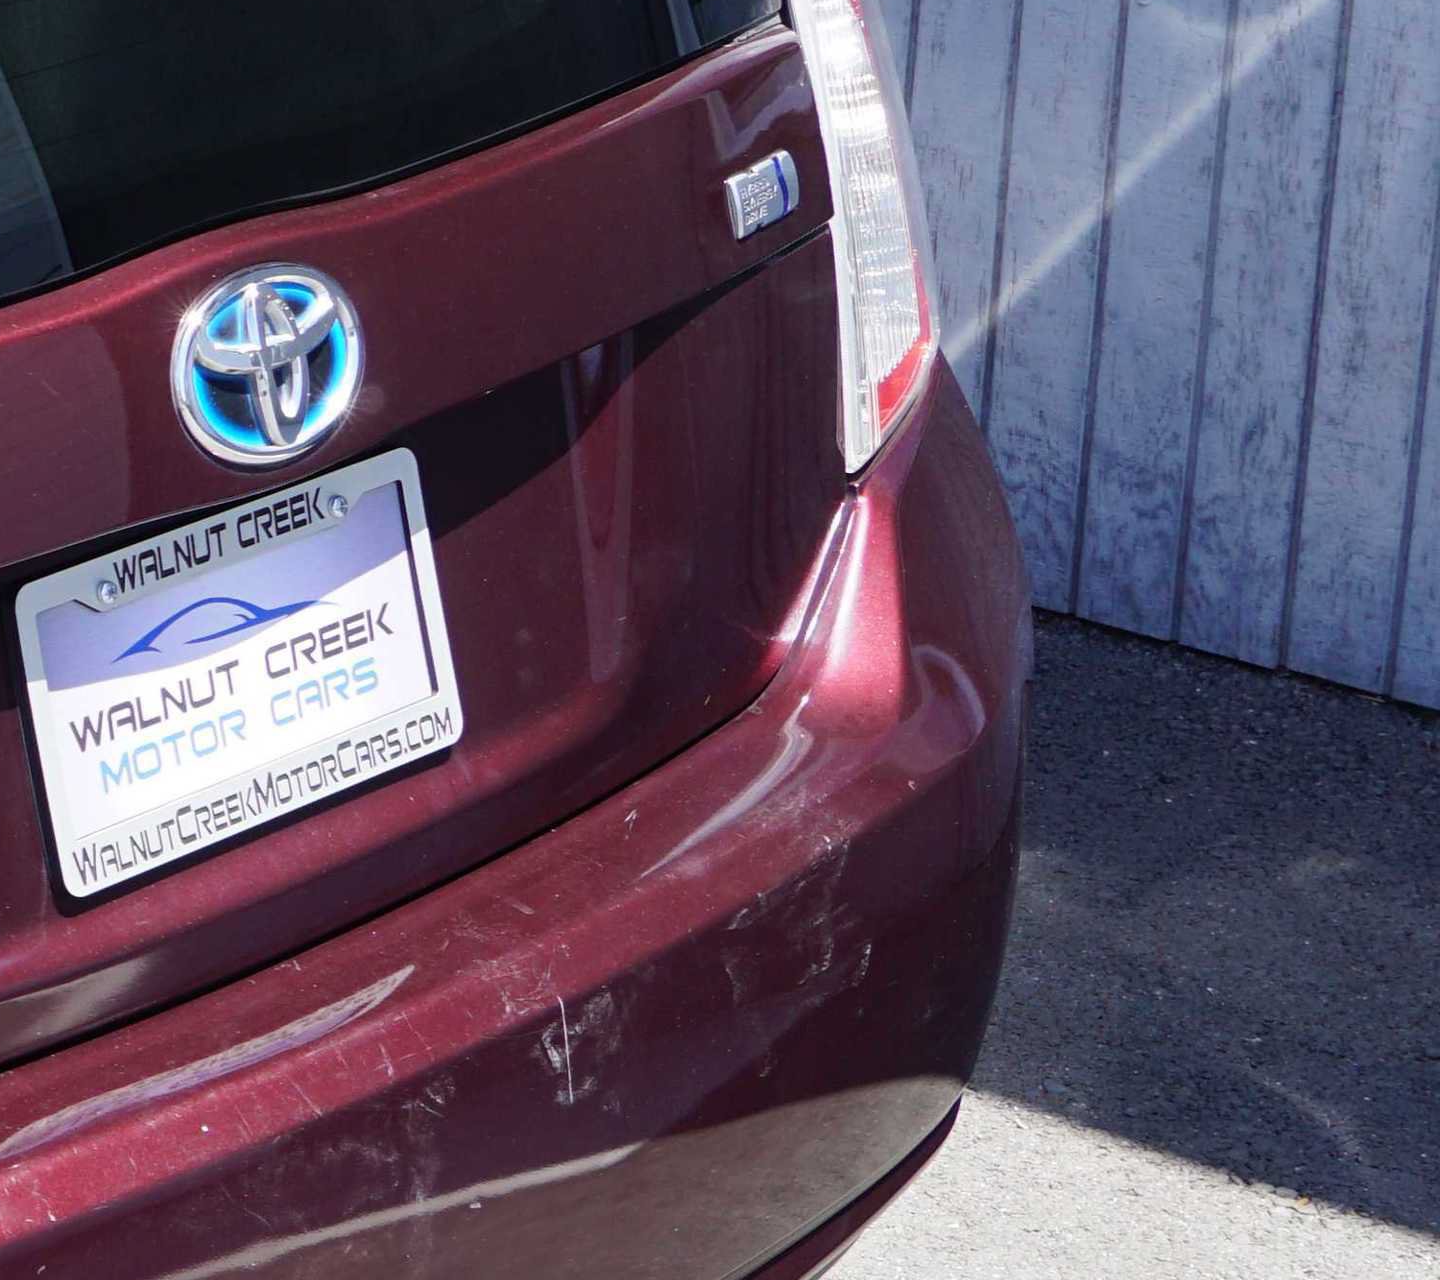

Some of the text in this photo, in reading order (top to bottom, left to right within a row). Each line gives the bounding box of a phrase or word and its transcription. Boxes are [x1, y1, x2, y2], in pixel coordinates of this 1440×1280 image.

[112, 486, 325, 595] WALNUT CREEK
[68, 601, 396, 753] WALNUT CREEK
[98, 656, 380, 795] MOTOR CARS
